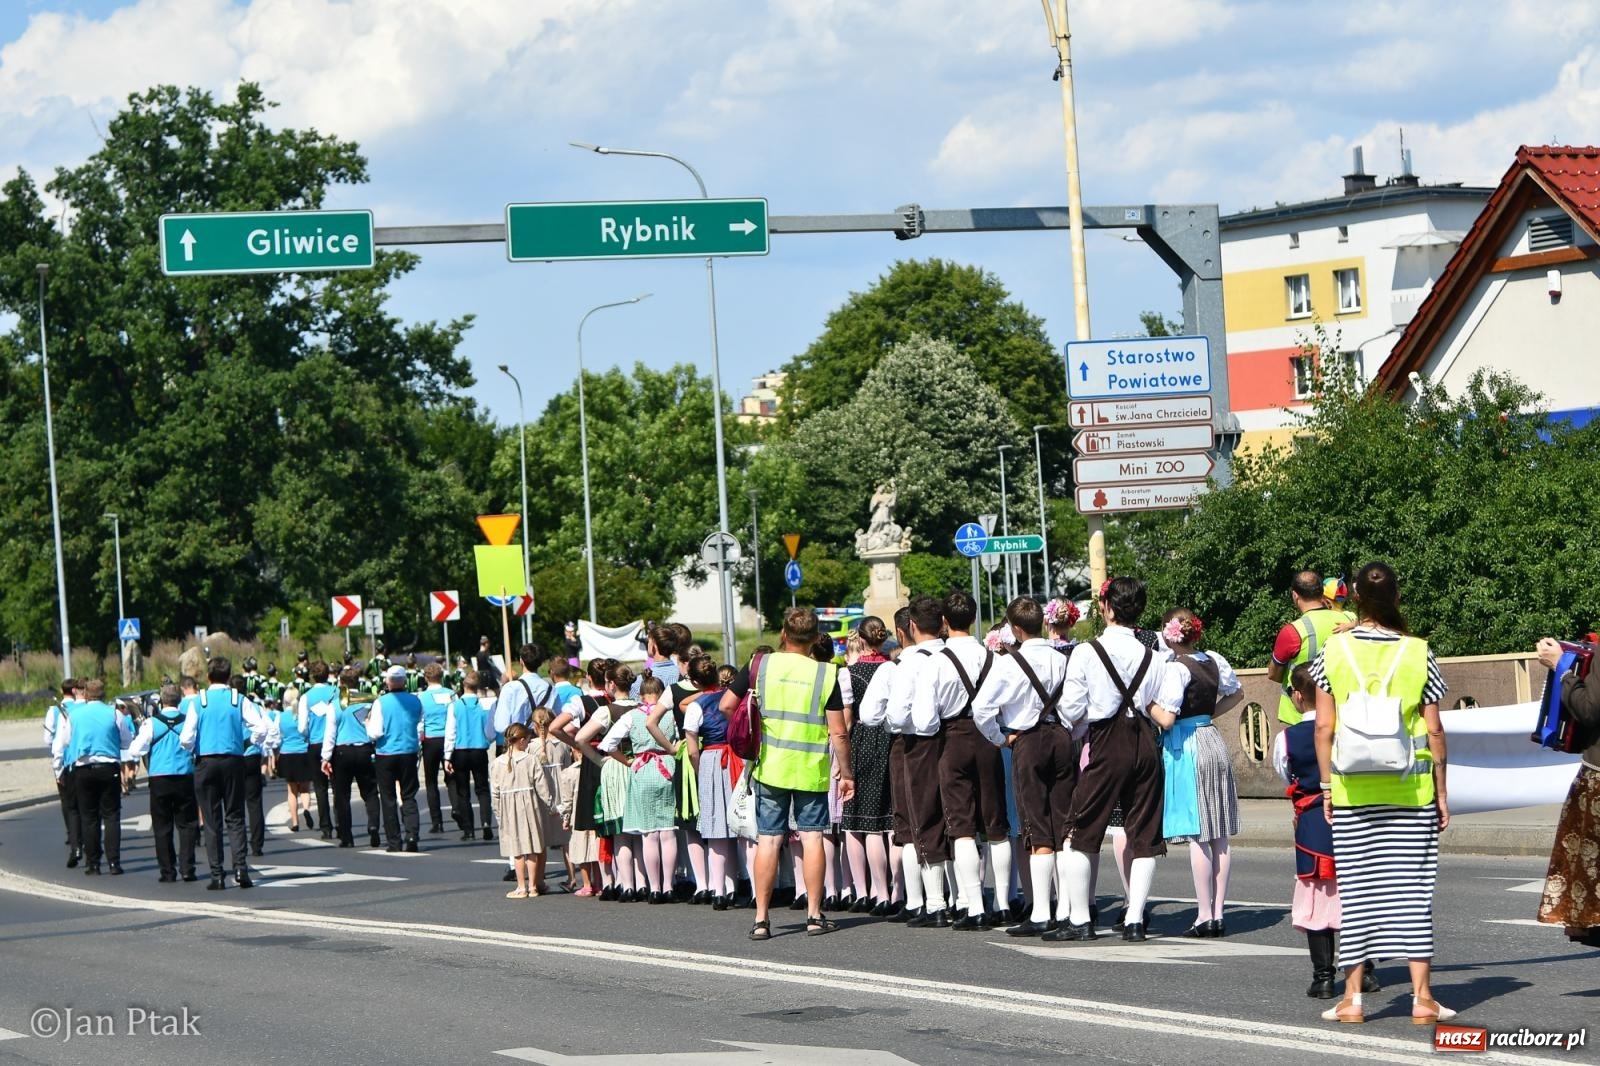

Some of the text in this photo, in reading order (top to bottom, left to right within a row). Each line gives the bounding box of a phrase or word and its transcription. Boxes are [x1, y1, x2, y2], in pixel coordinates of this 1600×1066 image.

[600, 216, 696, 250] Rybnik
[247, 227, 359, 256] Gliwice
[1107, 348, 1195, 365] Starostwo
[1108, 373, 1202, 389] Powiatowe
[1156, 408, 1207, 418] Chrzciciela
[1117, 438, 1165, 449] Piastowski
[1119, 460, 1185, 476] Mini ZOO
[1121, 497, 1150, 506] Bramy
[993, 540, 1029, 552] Rybnik
